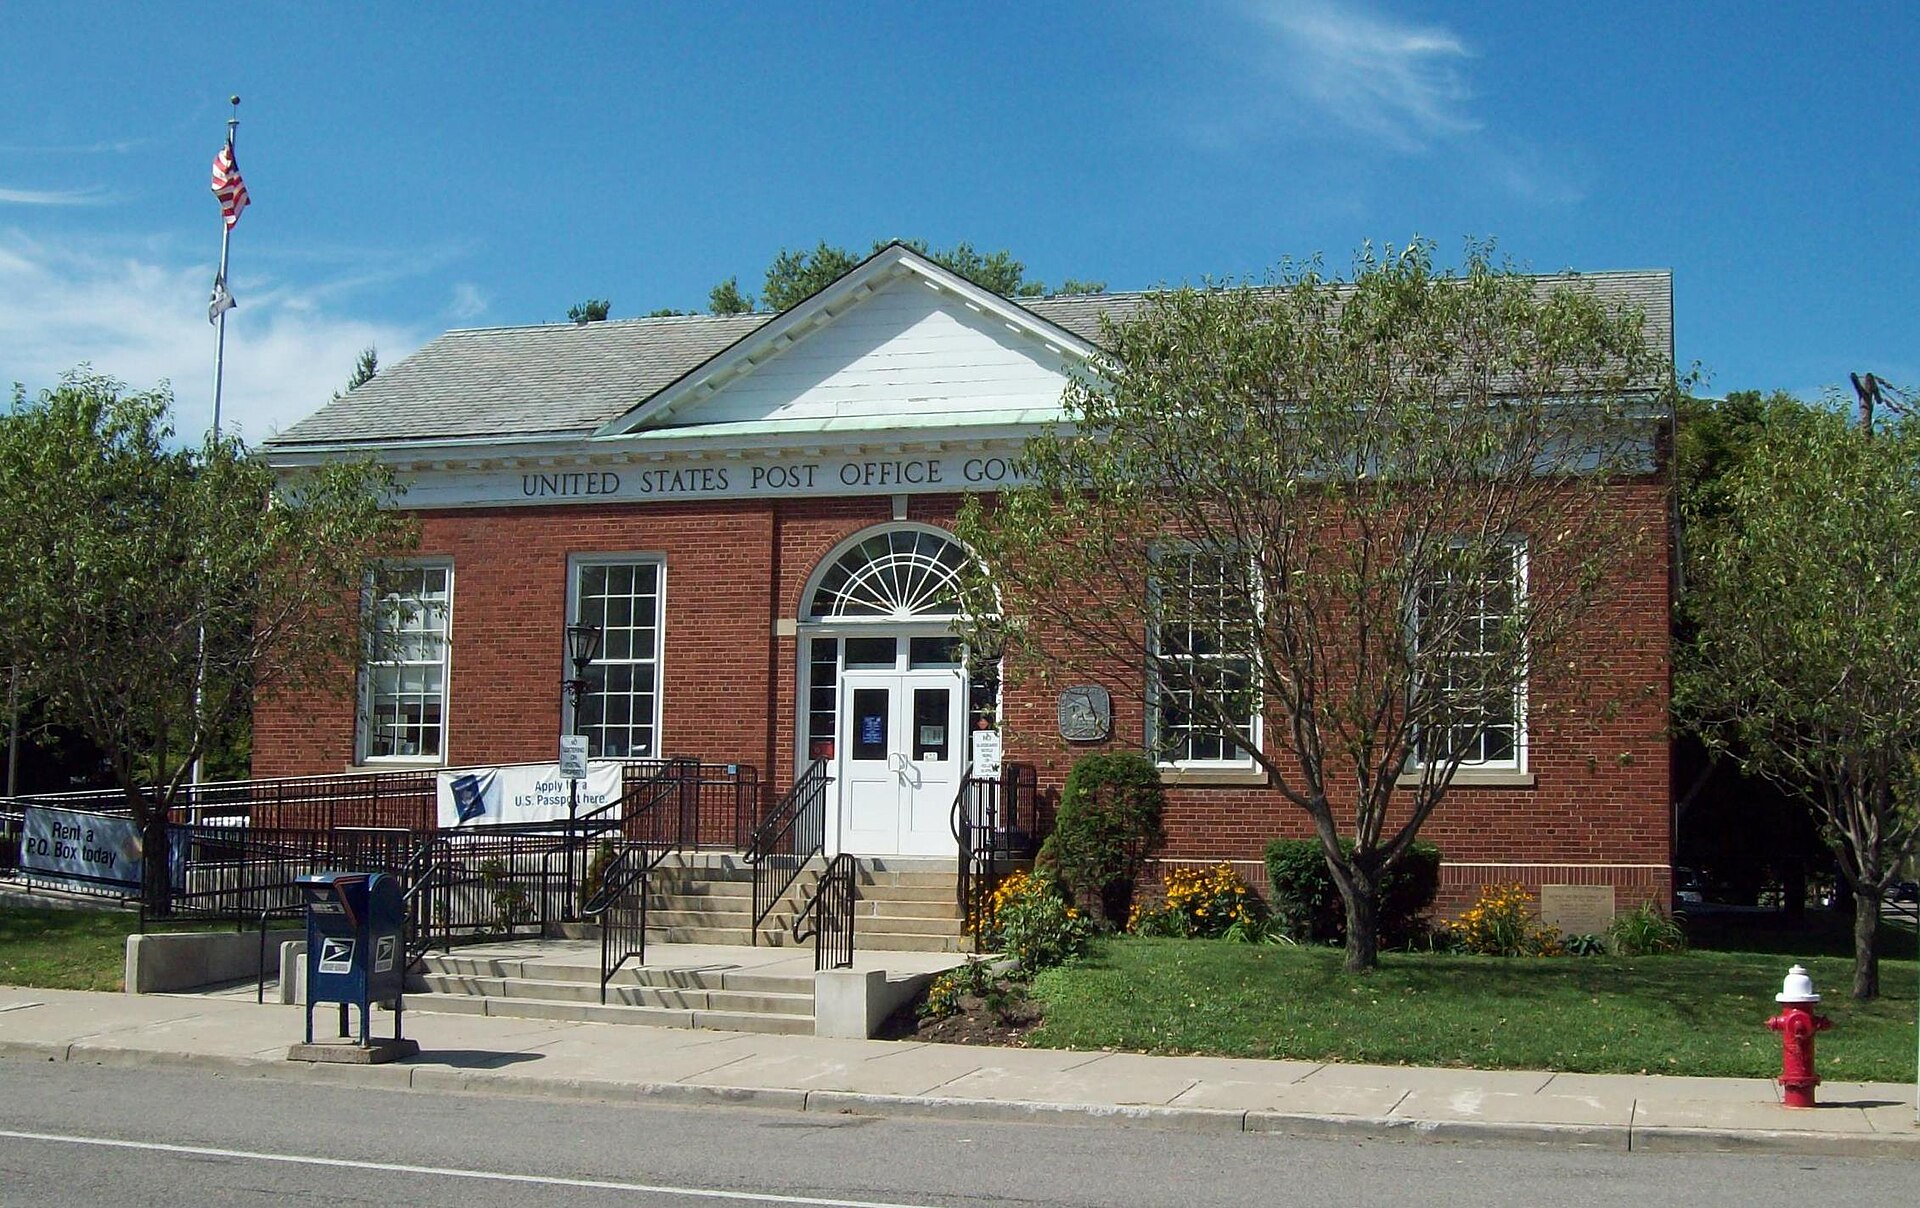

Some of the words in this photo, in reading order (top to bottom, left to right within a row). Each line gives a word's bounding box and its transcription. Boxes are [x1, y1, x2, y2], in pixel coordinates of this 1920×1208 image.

[522, 472, 620, 497] UNITED
[640, 468, 729, 493] STATES
[751, 463, 819, 489] POST
[840, 459, 942, 486] OFFICE
[535, 780, 563, 793] Apply
[582, 781, 587, 790] a
[515, 796, 534, 807] U.S.
[537, 794, 581, 807] Passpot
[53, 821, 81, 841] Rent
[86, 828, 94, 843] a
[28, 837, 50, 856] P.O.
[54, 840, 77, 860] Box
[82, 845, 117, 869] today
